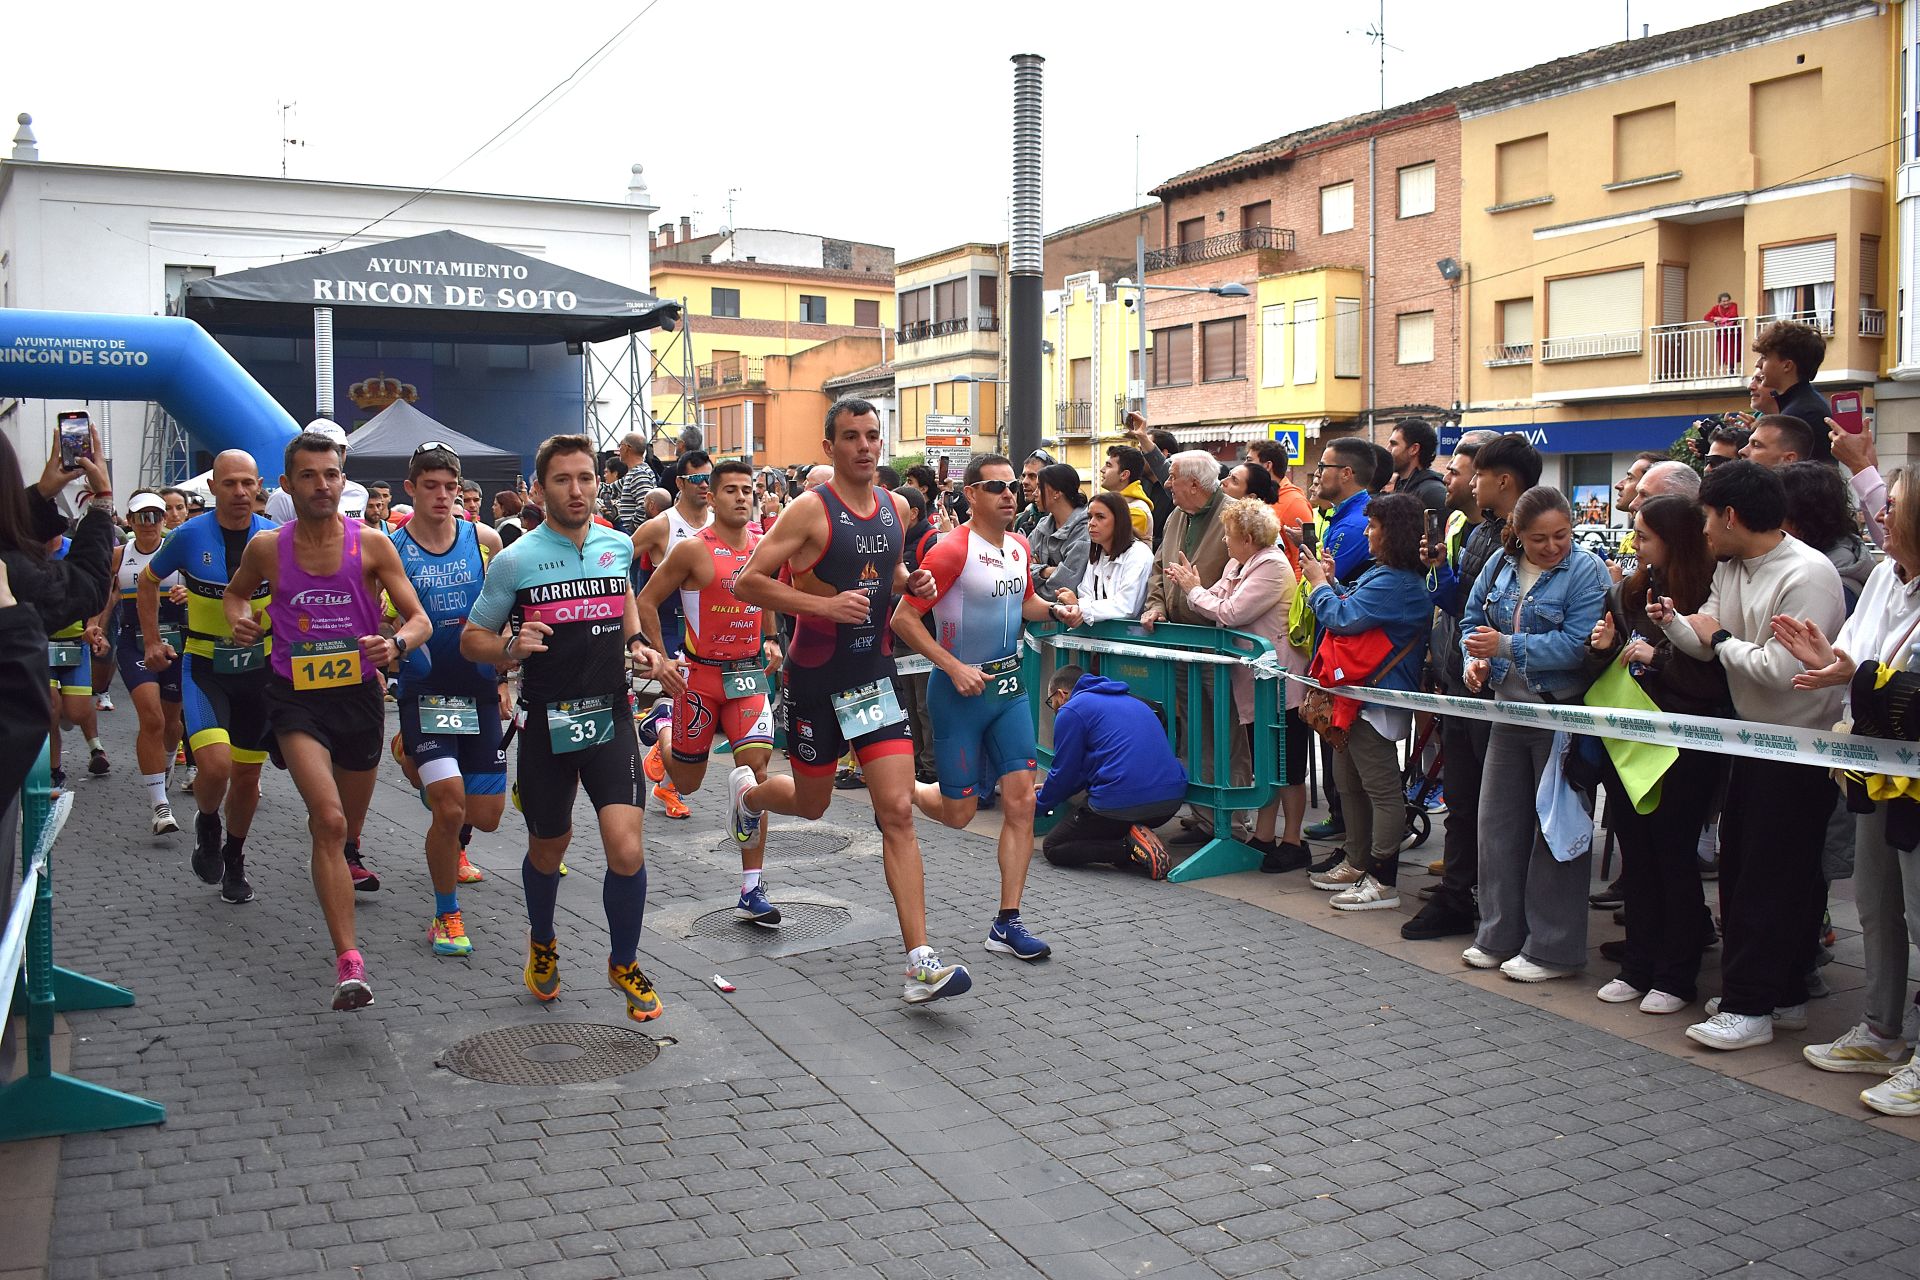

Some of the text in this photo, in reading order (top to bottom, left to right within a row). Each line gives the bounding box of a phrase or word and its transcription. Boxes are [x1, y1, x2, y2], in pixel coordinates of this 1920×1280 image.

[367, 257, 528, 279] AYUNTAMIENTO
[313, 279, 577, 311] RINCON DE SOTO
[15, 337, 126, 349] AYUNTAMIENTO DE
[69, 350, 94, 365] DE
[98, 351, 148, 366] SOTO
[1504, 427, 1548, 445] VA
[856, 534, 889, 553] GALILEA
[421, 558, 467, 575] ABLITAS
[416, 570, 471, 588] TRIATLÓN
[992, 575, 1024, 598] JORDI
[530, 579, 606, 603] KARRIKIRI
[430, 590, 467, 611] MELERO
[555, 599, 613, 621] ariza
[729, 619, 754, 629] PIÑAR
[59, 651, 66, 661] 1
[229, 652, 252, 668] 17
[303, 659, 352, 681] 142
[735, 676, 756, 691] 30
[998, 676, 1018, 695] 23
[436, 714, 463, 728] 26
[855, 704, 884, 726] 16
[1634, 718, 1653, 726] RURAL
[569, 719, 597, 742] 33
[1629, 724, 1656, 733] NAVARRA
[1684, 724, 1720, 735] CAJA RURAL
[1694, 732, 1724, 742] NAVARRA
[1754, 733, 1794, 744] CAJA RURAL
[1754, 747, 1796, 758] ACCIÓN SOCIAL
[1766, 741, 1797, 751] NAVARRA
[1831, 742, 1875, 753] CAJA RURAL
[1831, 757, 1878, 768] ACCIÓN SOCIAL
[1843, 750, 1879, 761] NAVARRA
